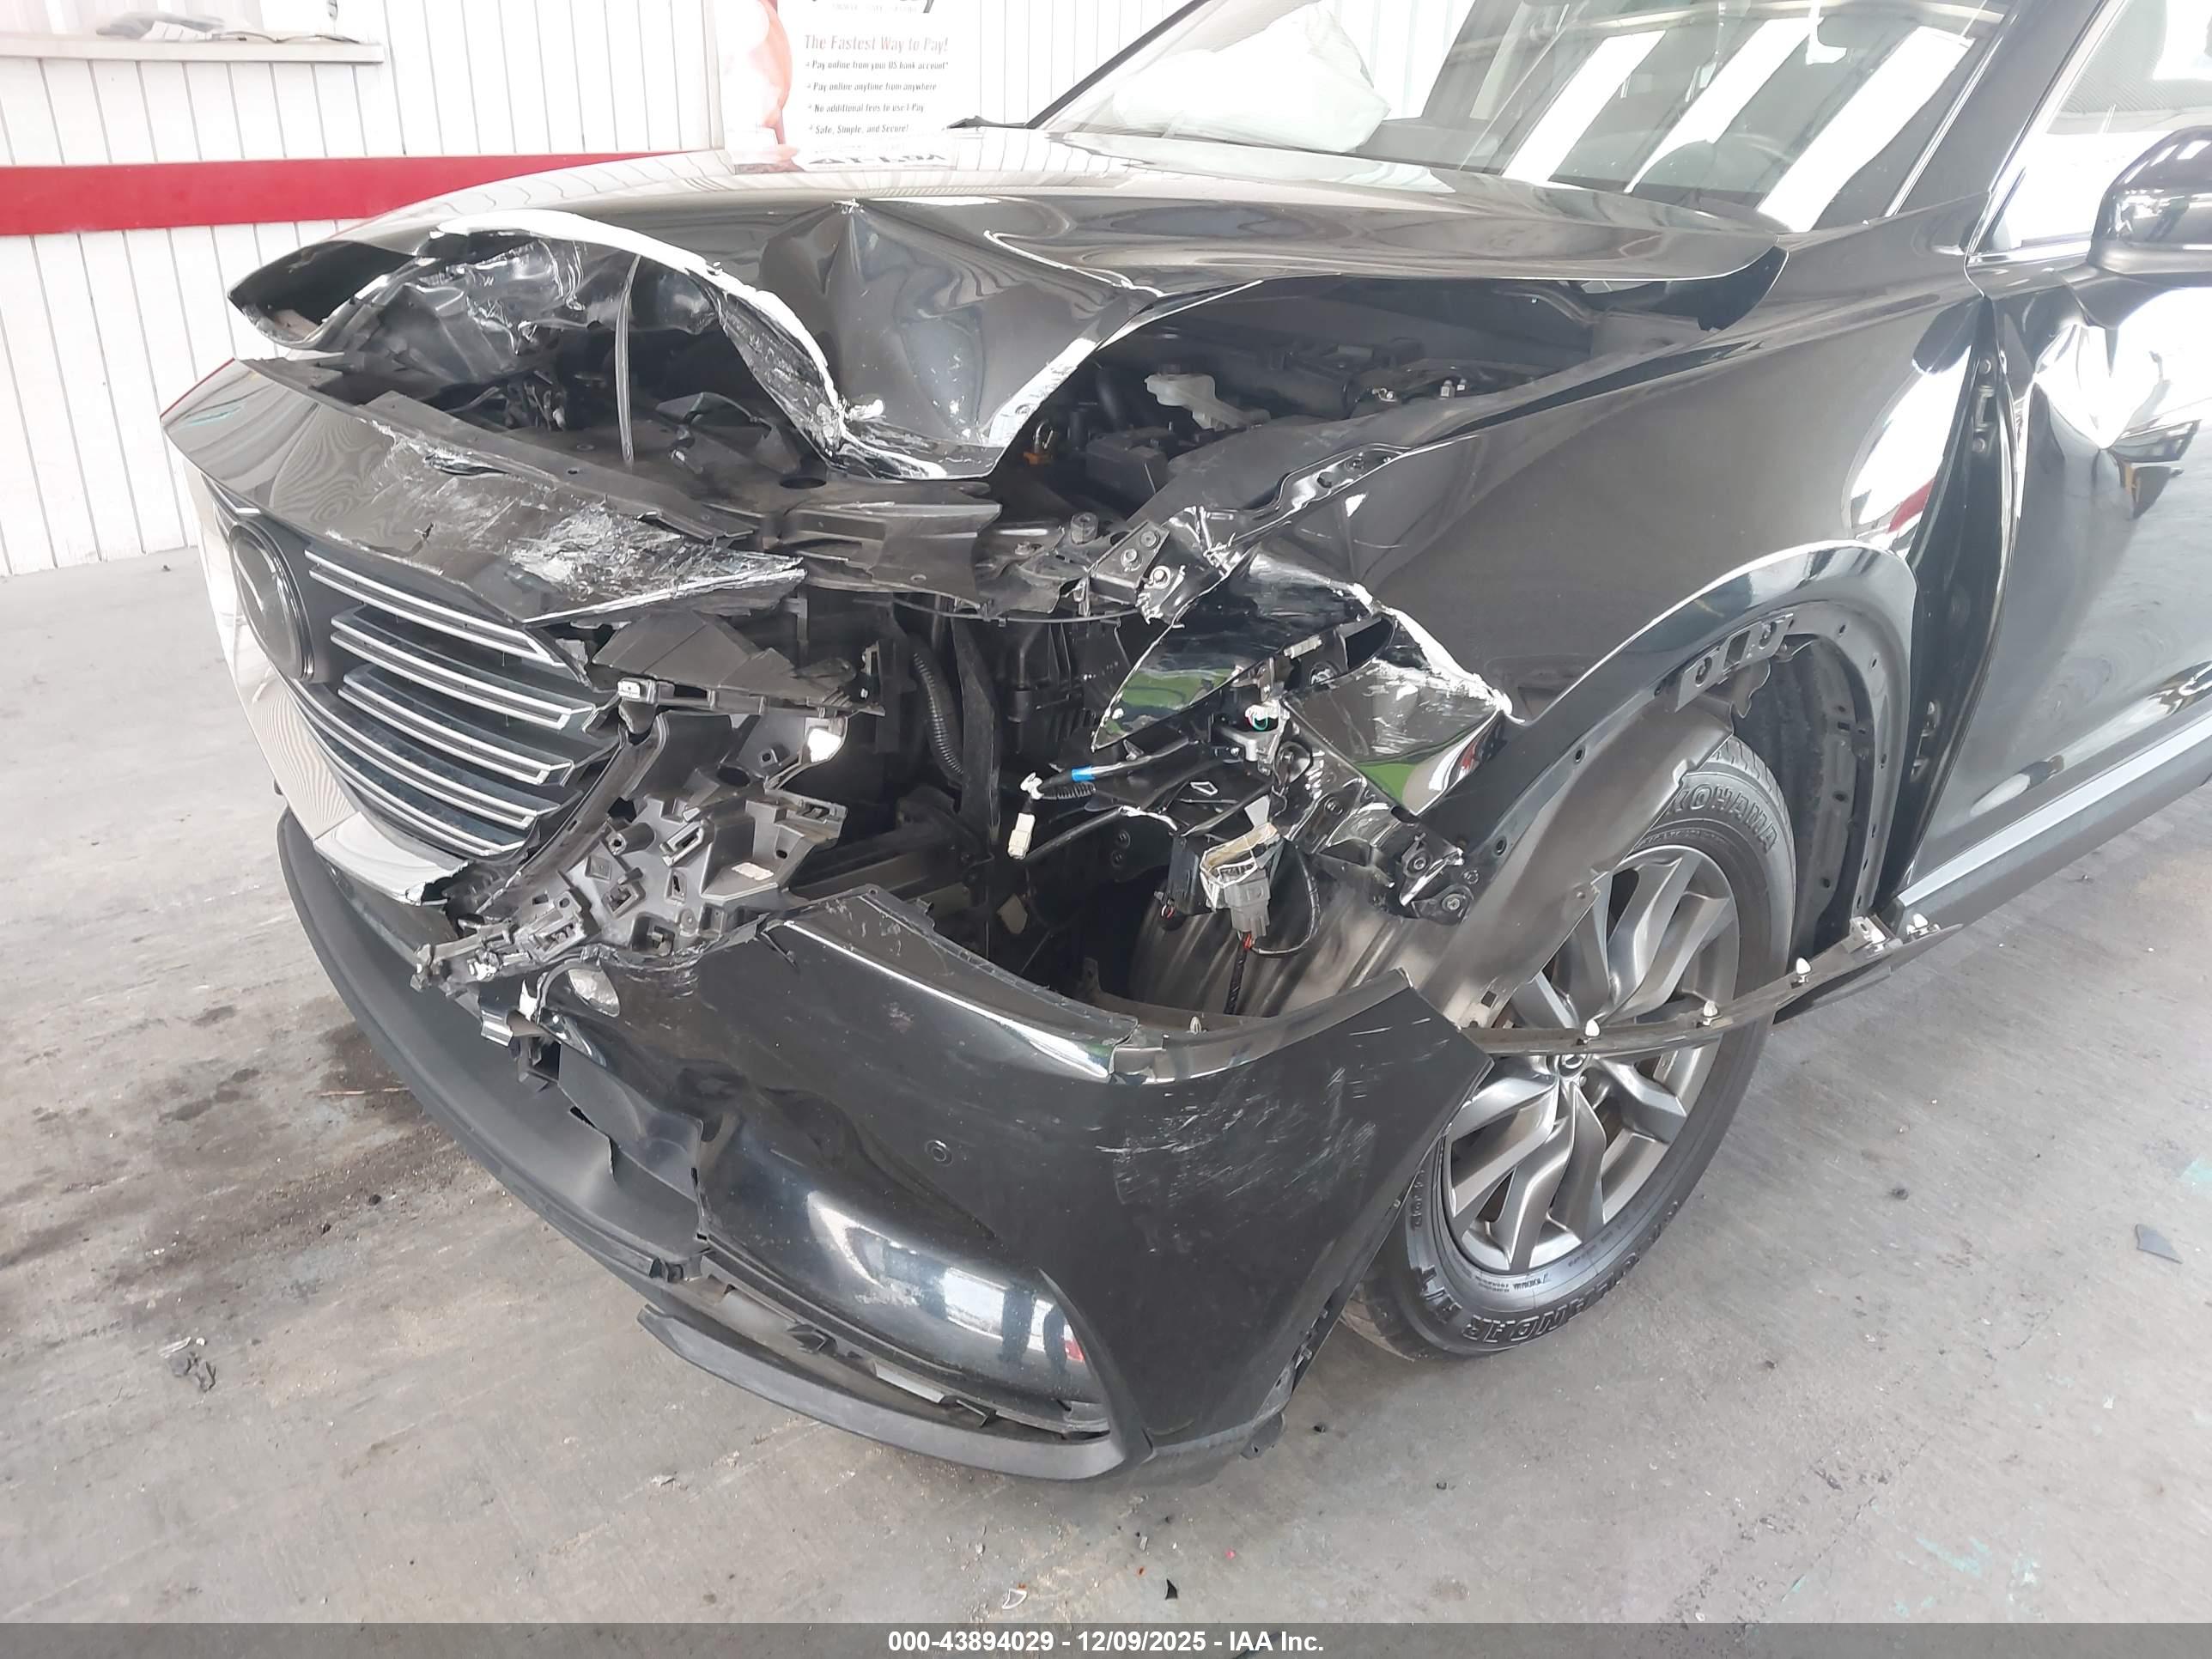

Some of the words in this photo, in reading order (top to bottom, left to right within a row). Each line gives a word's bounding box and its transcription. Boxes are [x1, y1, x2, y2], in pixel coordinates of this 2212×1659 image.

[805, 34, 826, 50] The
[830, 35, 876, 51] Fastest
[881, 37, 902, 53] Way
[908, 37, 920, 51] to
[923, 37, 949, 55] Pay!
[811, 60, 825, 70] Pay
[828, 60, 850, 70] online
[853, 61, 869, 70] from
[871, 62, 886, 71] your
[888, 61, 897, 70] US
[899, 61, 915, 70] bank
[813, 82, 827, 93] Pay
[830, 82, 852, 91] online
[854, 82, 883, 93] anytime
[885, 82, 902, 91] from
[903, 82, 937, 93] anywhere
[814, 103, 824, 112] No
[826, 103, 864, 112] additional
[866, 103, 880, 112] fees
[883, 103, 890, 112] to
[815, 125, 835, 136] Safe,
[837, 125, 864, 136] Simple,
[866, 125, 880, 133] and
[882, 124, 908, 133] Secure!
[1667, 783, 1778, 854] KOHAMA
